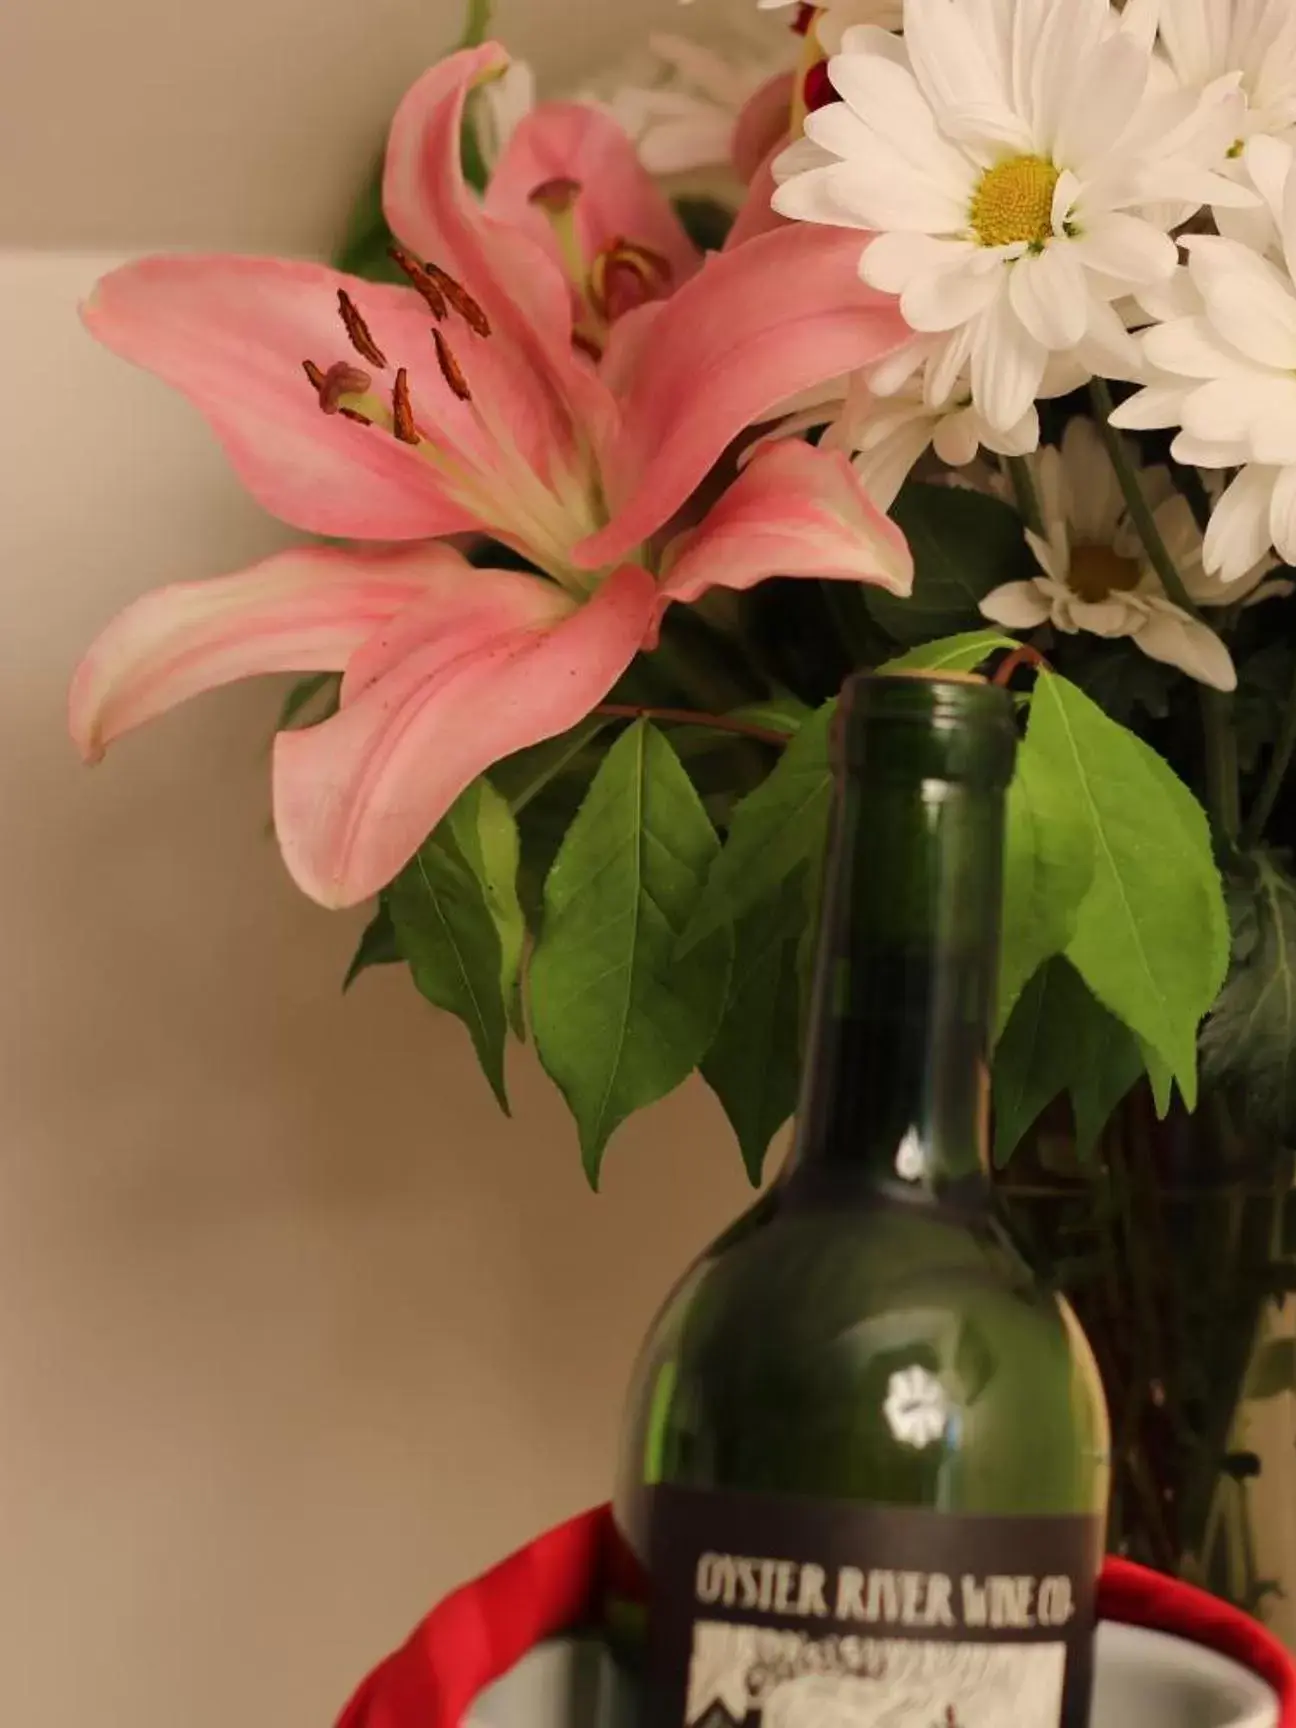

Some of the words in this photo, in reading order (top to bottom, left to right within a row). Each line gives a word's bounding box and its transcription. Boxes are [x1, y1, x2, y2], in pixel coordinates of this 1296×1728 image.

[696, 1552, 829, 1617] OYSTER
[835, 1567, 956, 1627] RIVER
[961, 1574, 1036, 1628] WINE
